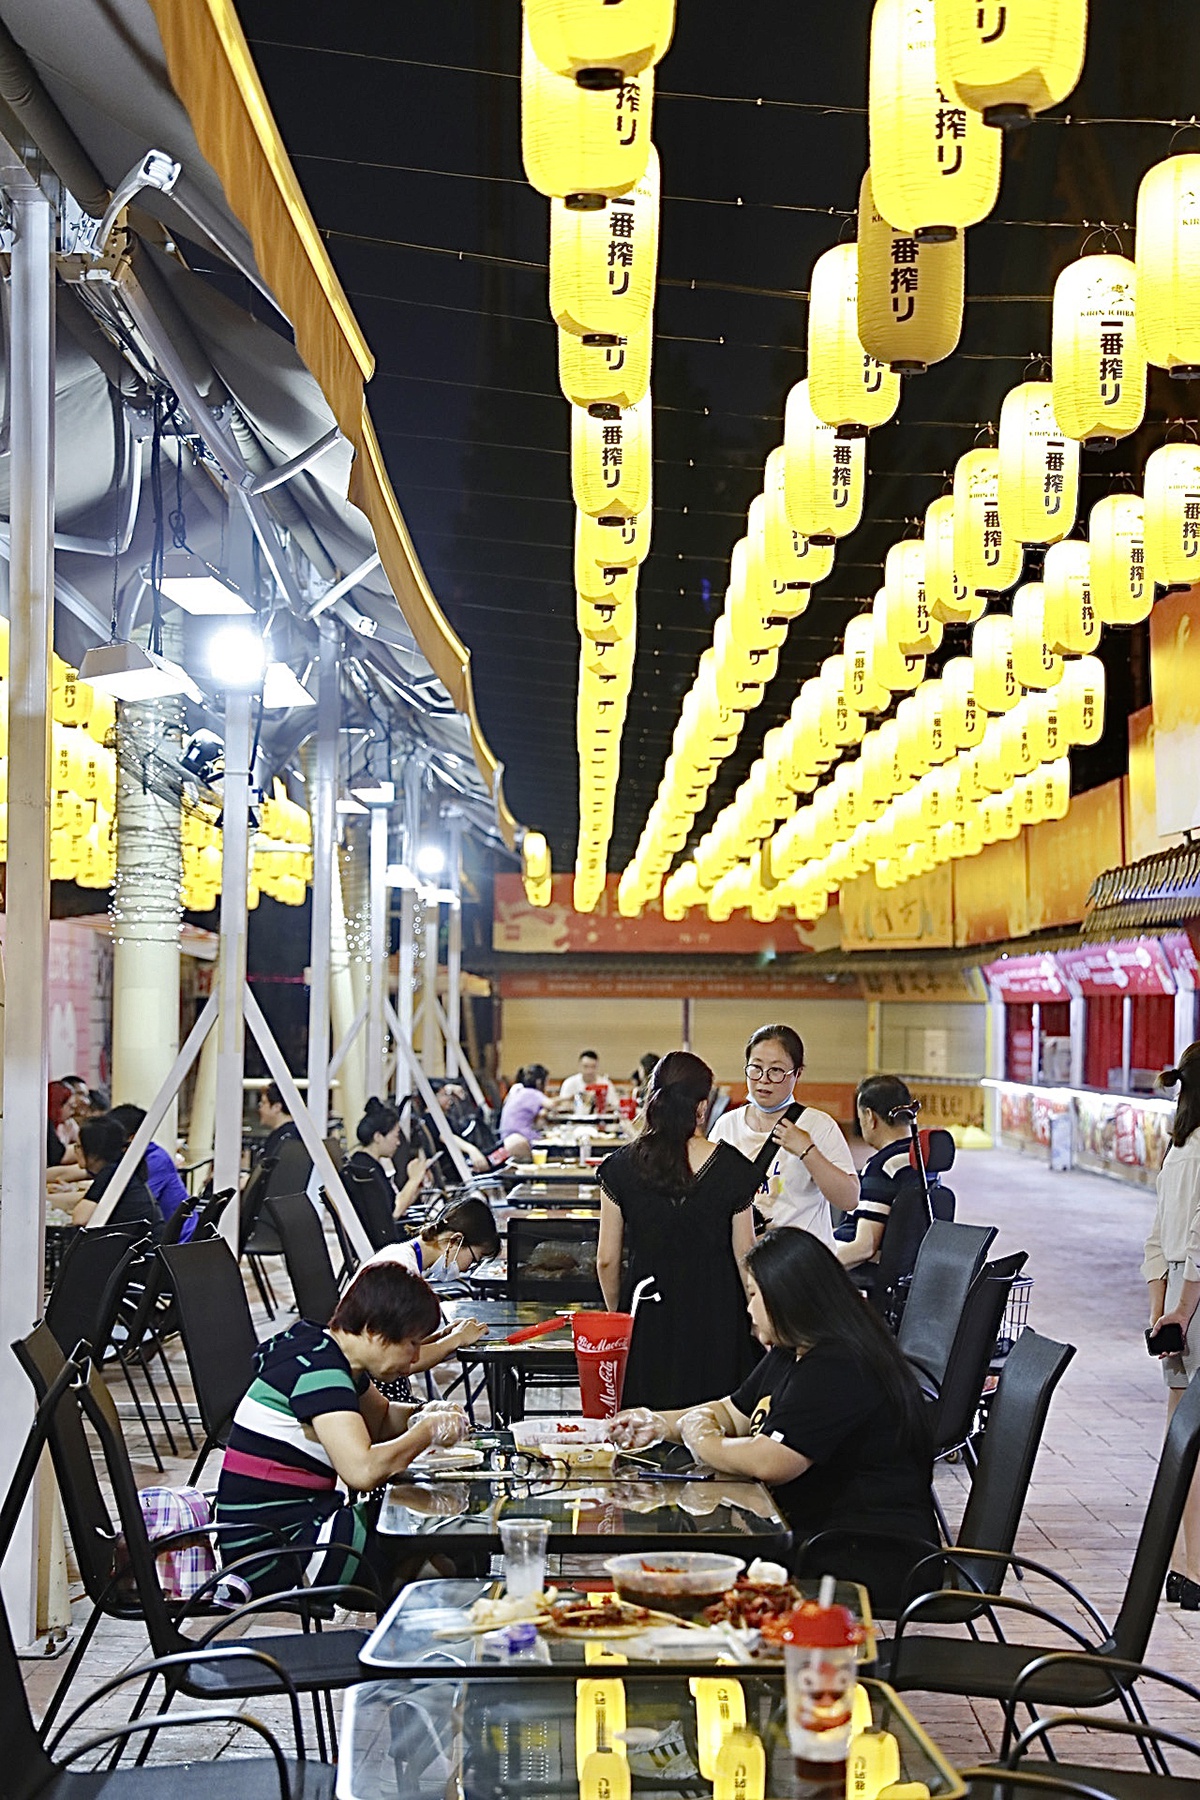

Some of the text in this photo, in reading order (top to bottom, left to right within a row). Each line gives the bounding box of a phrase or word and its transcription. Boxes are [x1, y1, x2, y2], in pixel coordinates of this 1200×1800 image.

[607, 197, 636, 296] 一番搾り
[1099, 320, 1124, 405] 一番搾り
[1044, 441, 1065, 515] 一番搾り
[984, 502, 1002, 566] 一番搾り
[1182, 493, 1200, 557] 一番搾り
[1130, 540, 1144, 598] 一番搾り
